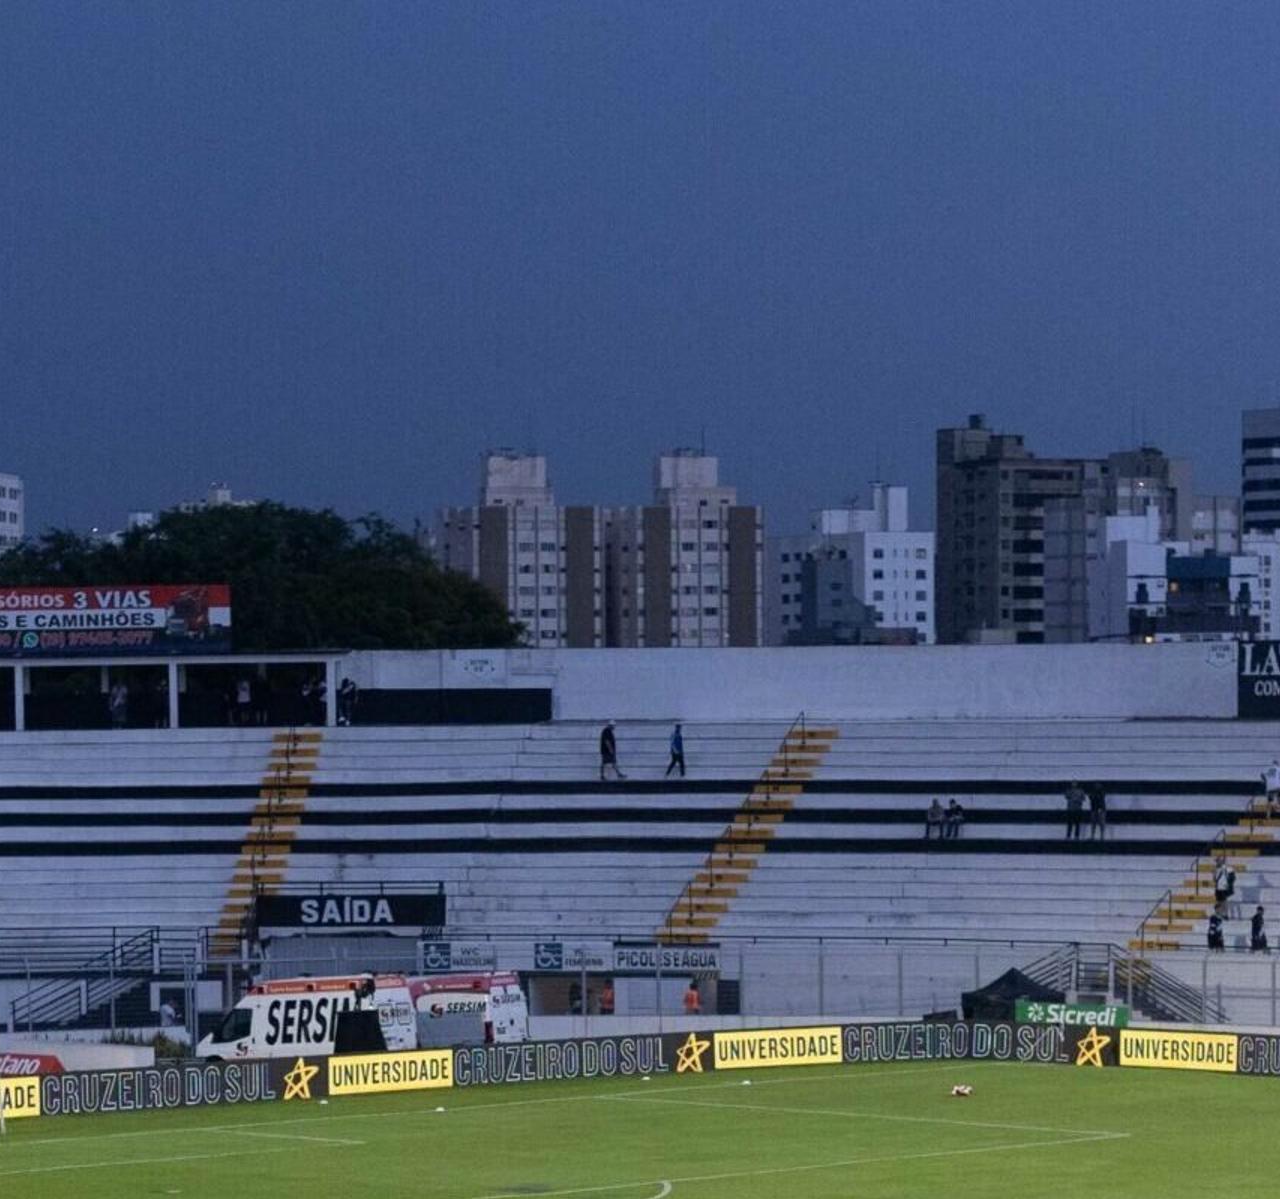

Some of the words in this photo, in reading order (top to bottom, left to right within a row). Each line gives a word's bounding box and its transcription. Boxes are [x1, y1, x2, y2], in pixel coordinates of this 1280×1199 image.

[73, 591, 87, 609] 3
[95, 590, 151, 608] VIAS
[15, 614, 28, 628] E
[34, 609, 155, 627] CAMINHÕES
[300, 896, 394, 924] SAÍDA
[460, 946, 480, 956] WC
[265, 997, 360, 1045] SERSI
[445, 1001, 487, 1014] SERSIM
[1046, 1003, 1117, 1026] Sicredi
[718, 1033, 839, 1062] UNIVERSIDADE
[843, 1022, 970, 1062] CRUZEIRO
[972, 1022, 1012, 1058] DO
[1016, 1024, 1070, 1063] SUL
[1123, 1036, 1234, 1064] UNIVERSIDADE
[332, 1056, 450, 1087] UNIVERSIDADE
[454, 1041, 579, 1087] CRUZEIRO
[582, 1039, 617, 1077] DO
[620, 1036, 669, 1074] SUL
[41, 1066, 180, 1115] CRUZEIRO
[184, 1065, 222, 1106] DO
[224, 1061, 276, 1101] SUL
